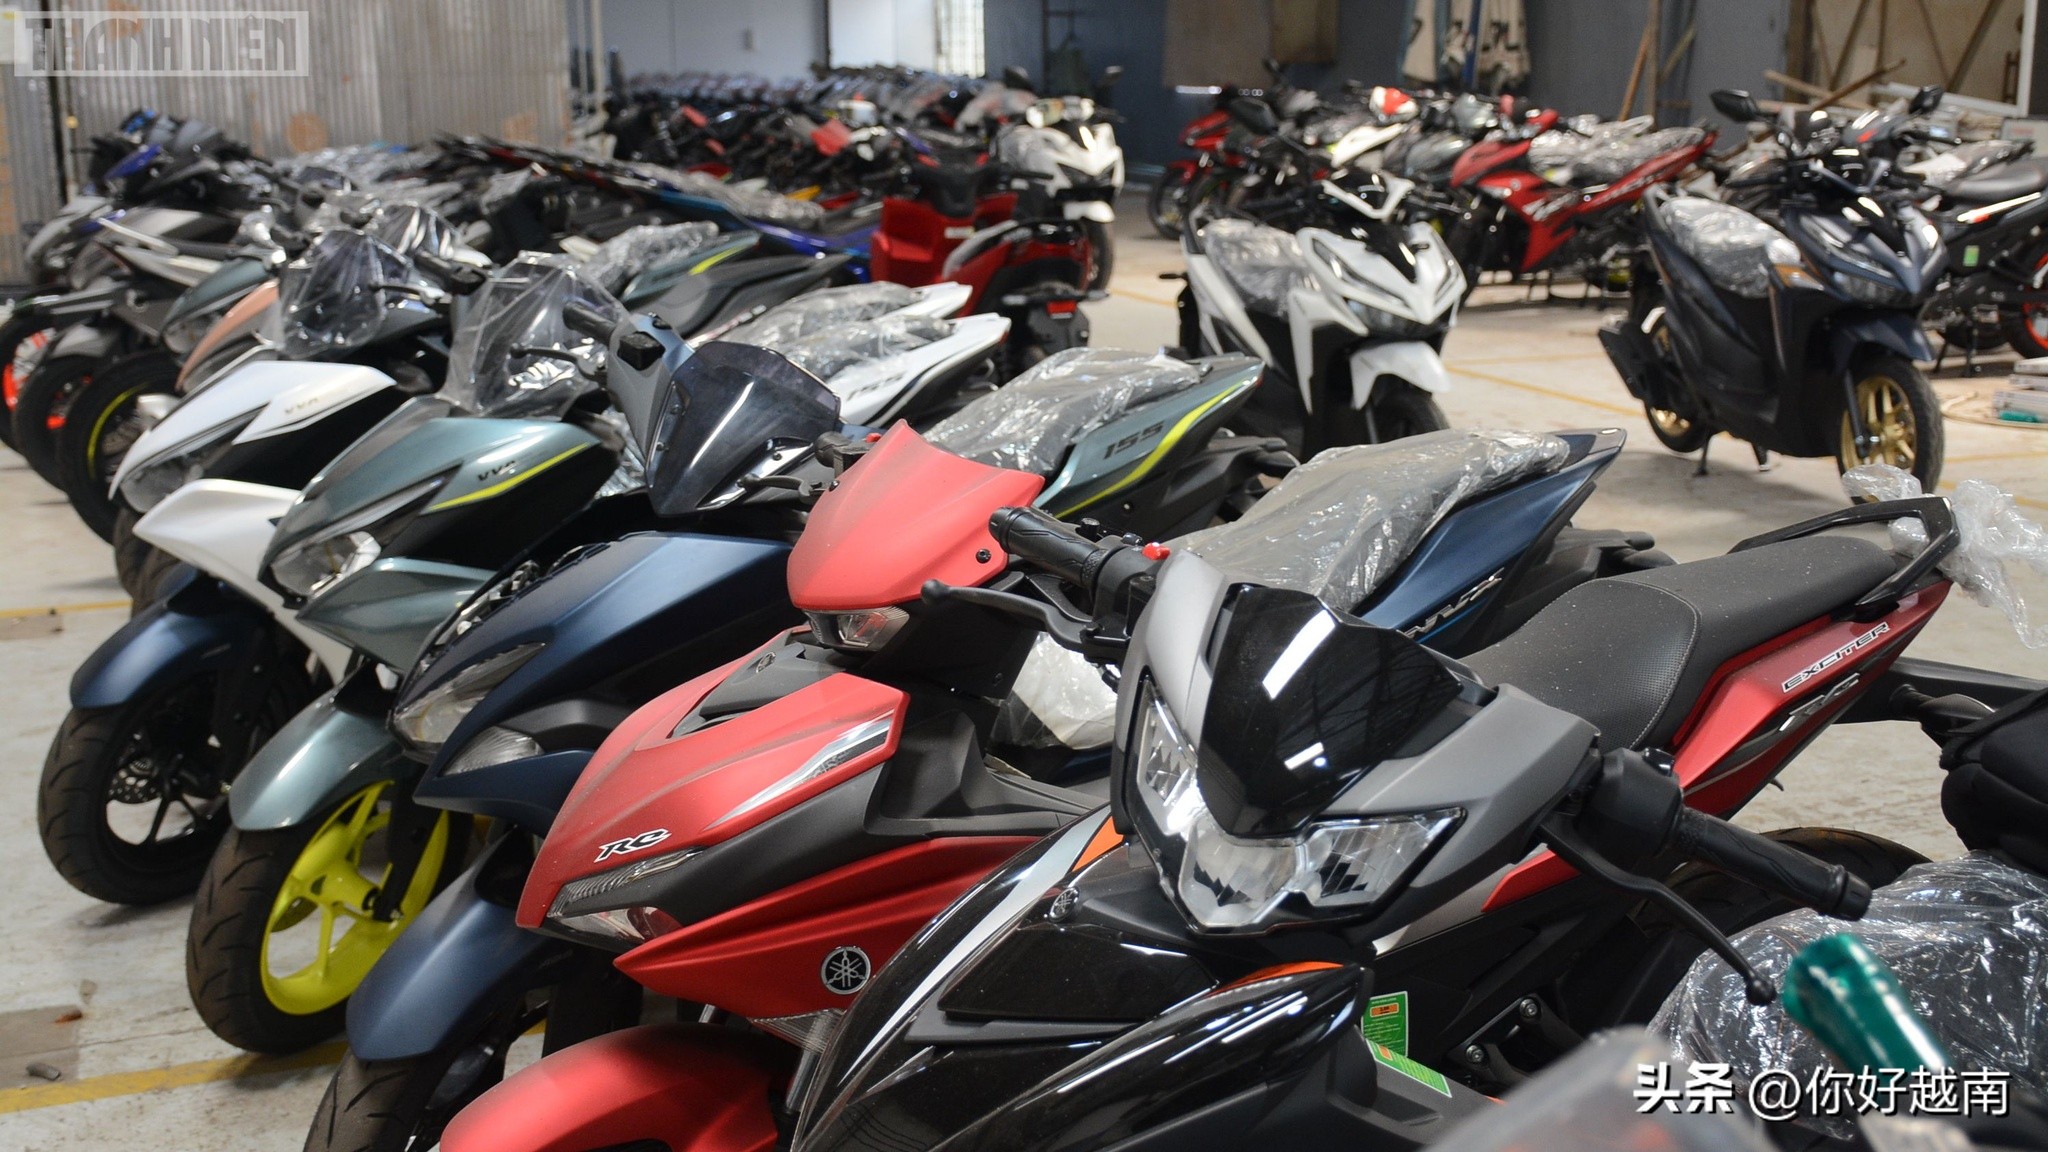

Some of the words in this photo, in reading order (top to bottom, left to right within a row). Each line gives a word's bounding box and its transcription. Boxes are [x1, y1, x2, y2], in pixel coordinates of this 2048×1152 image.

[1103, 420, 1165, 460] 155
[1781, 621, 1890, 693] EXCITER
[593, 828, 672, 863] RC
